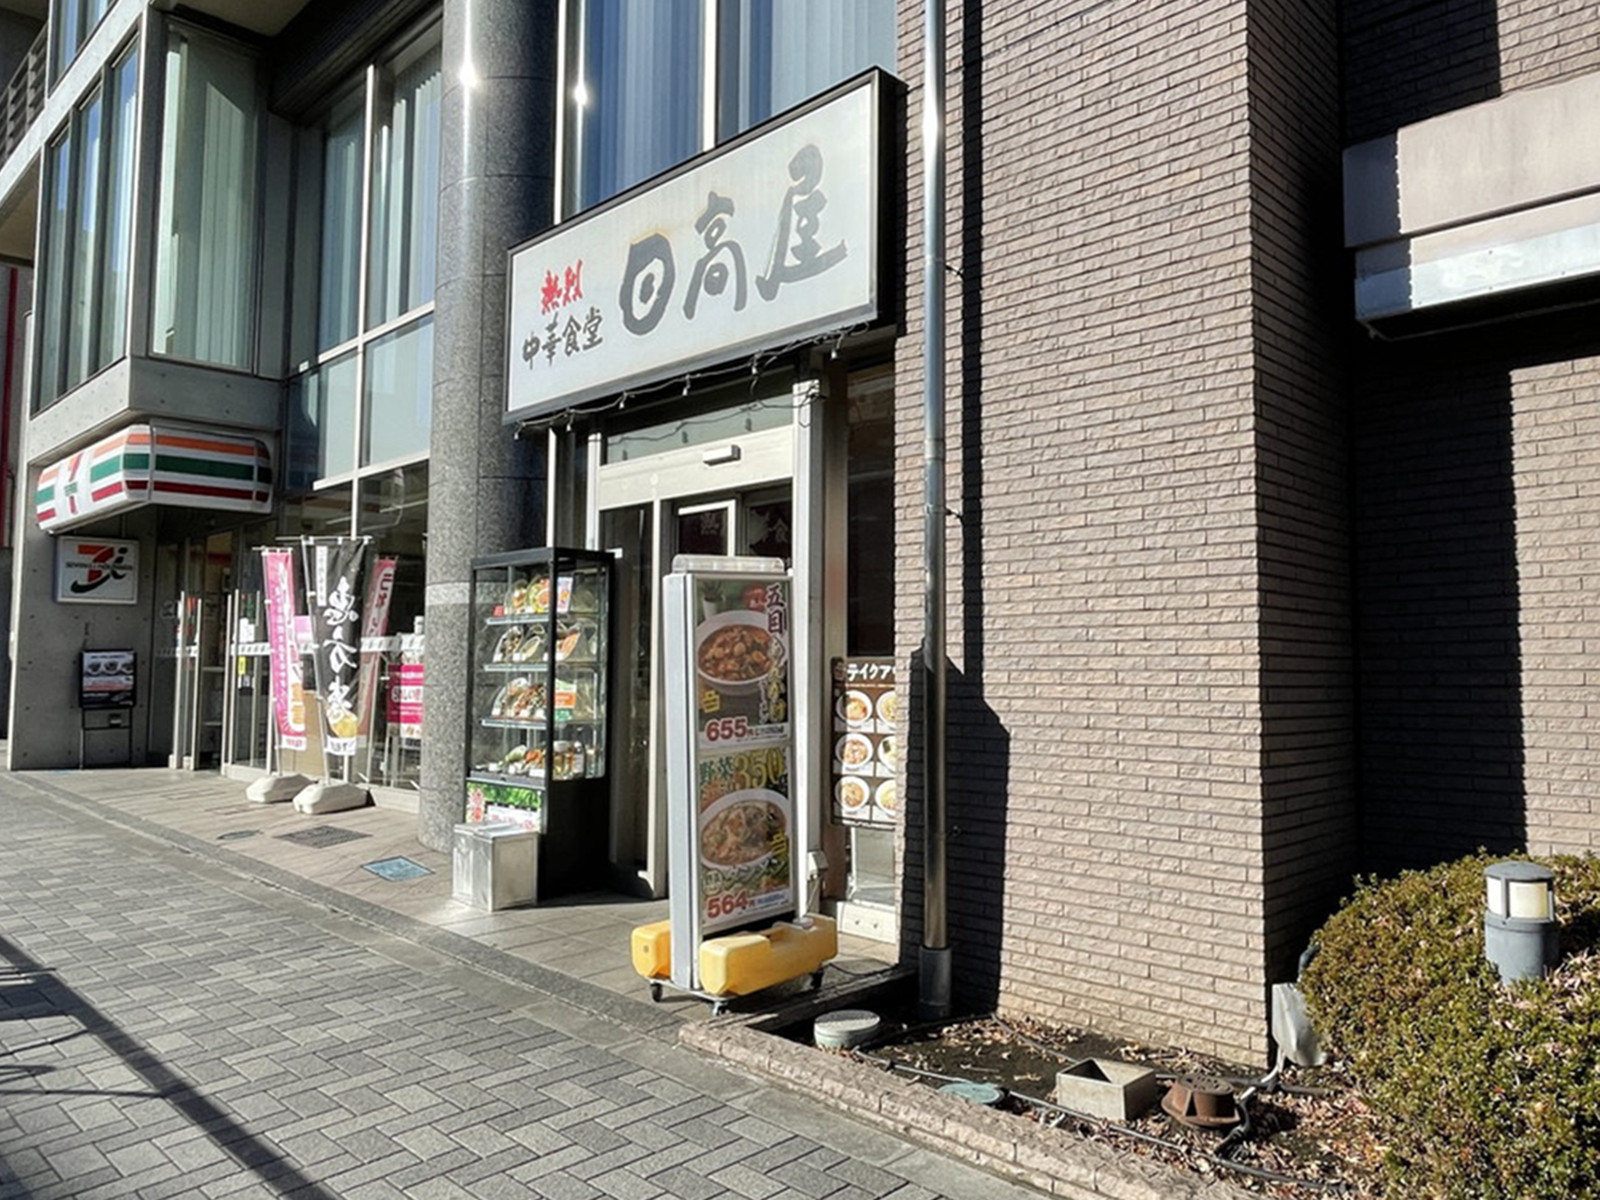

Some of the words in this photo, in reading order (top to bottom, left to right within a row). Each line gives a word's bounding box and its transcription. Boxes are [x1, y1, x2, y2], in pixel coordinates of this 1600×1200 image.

[620, 144, 848, 336] 日高屋
[541, 259, 583, 315] 熱烈
[522, 306, 604, 370] 中華食堂
[847, 663, 896, 682] テイクア
